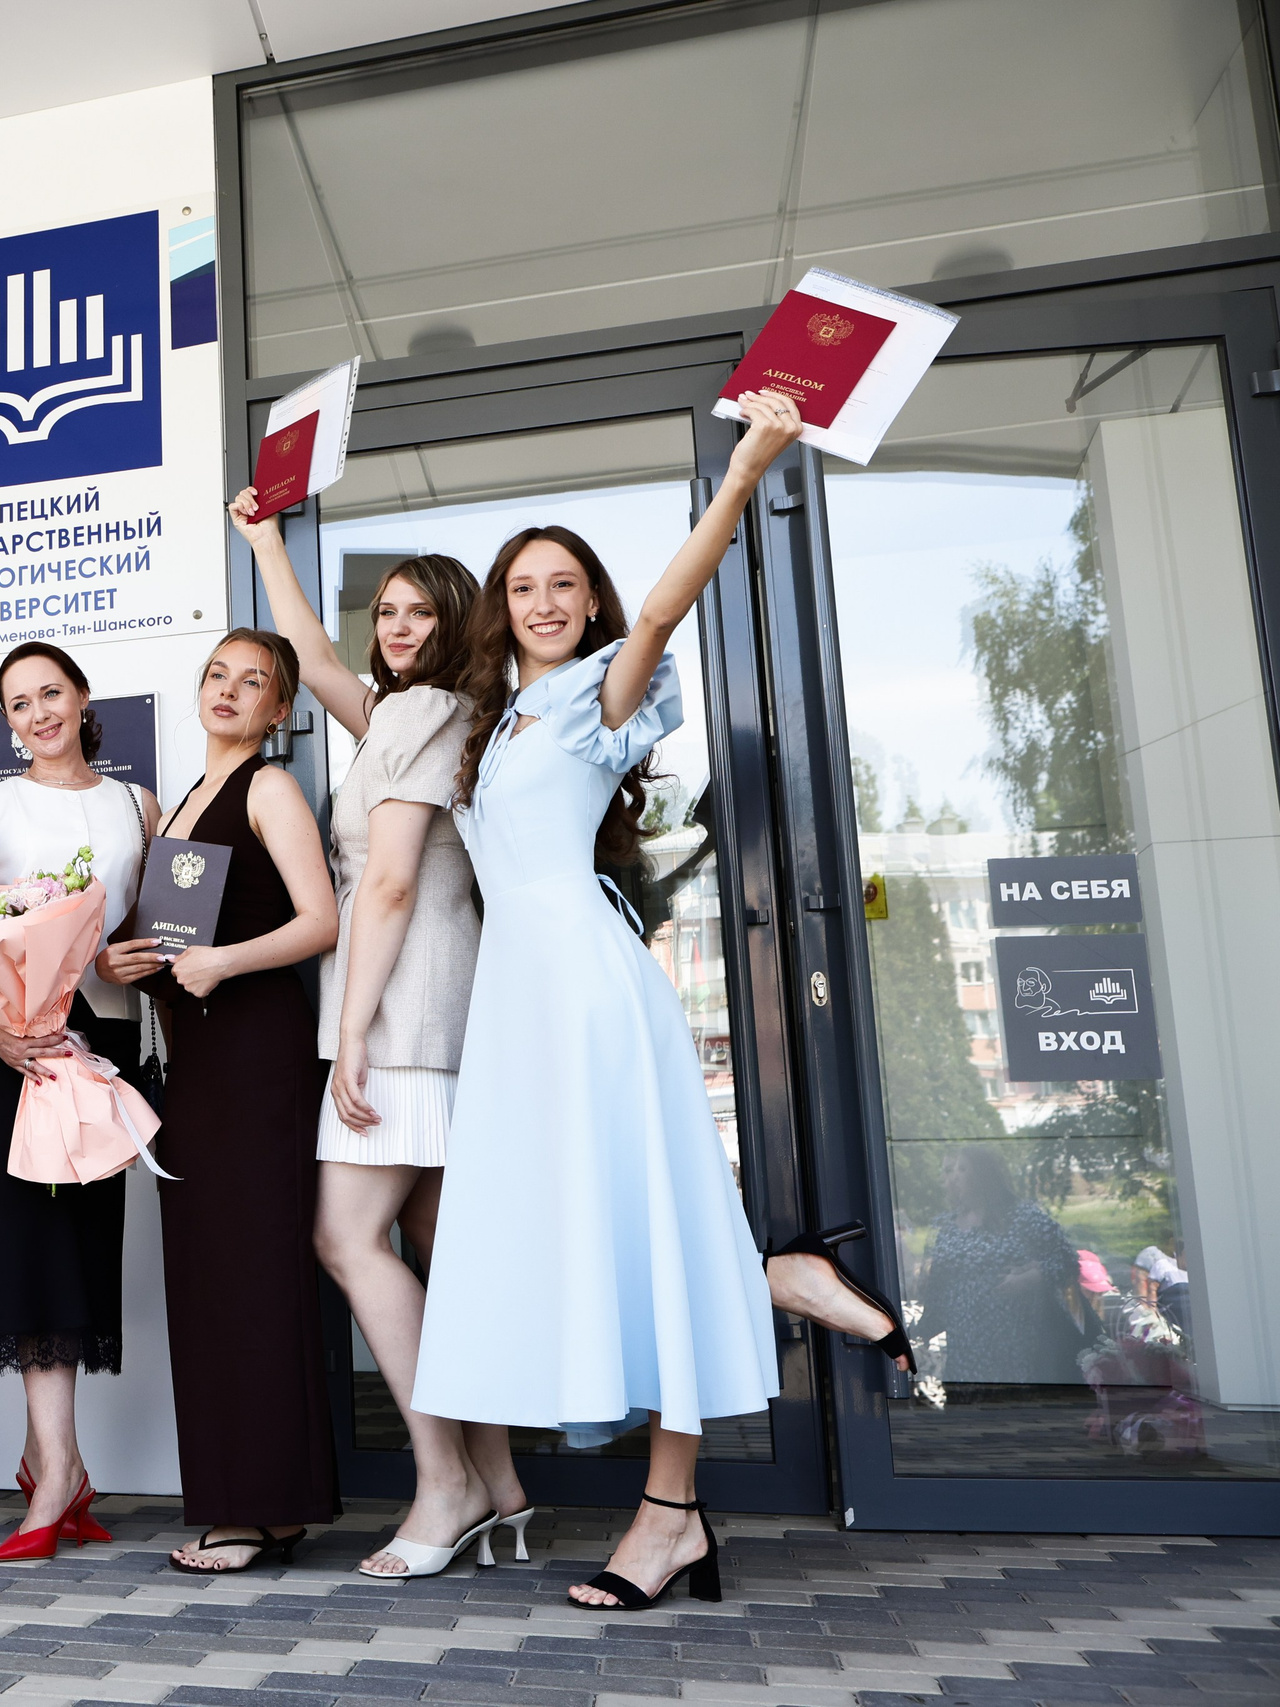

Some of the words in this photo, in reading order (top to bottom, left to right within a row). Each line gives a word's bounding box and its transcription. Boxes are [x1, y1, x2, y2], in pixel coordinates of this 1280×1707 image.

[762, 368, 825, 391] ДИПЛОМ
[263, 475, 296, 496] ДИПЛОМ
[87, 759, 112, 767] ЕТНОЕ
[1000, 882, 1042, 901] НА
[1050, 879, 1131, 900] СЕБЯ
[151, 921, 197, 935] ДИПЛОМ
[1038, 1030, 1126, 1054] ВХОД
